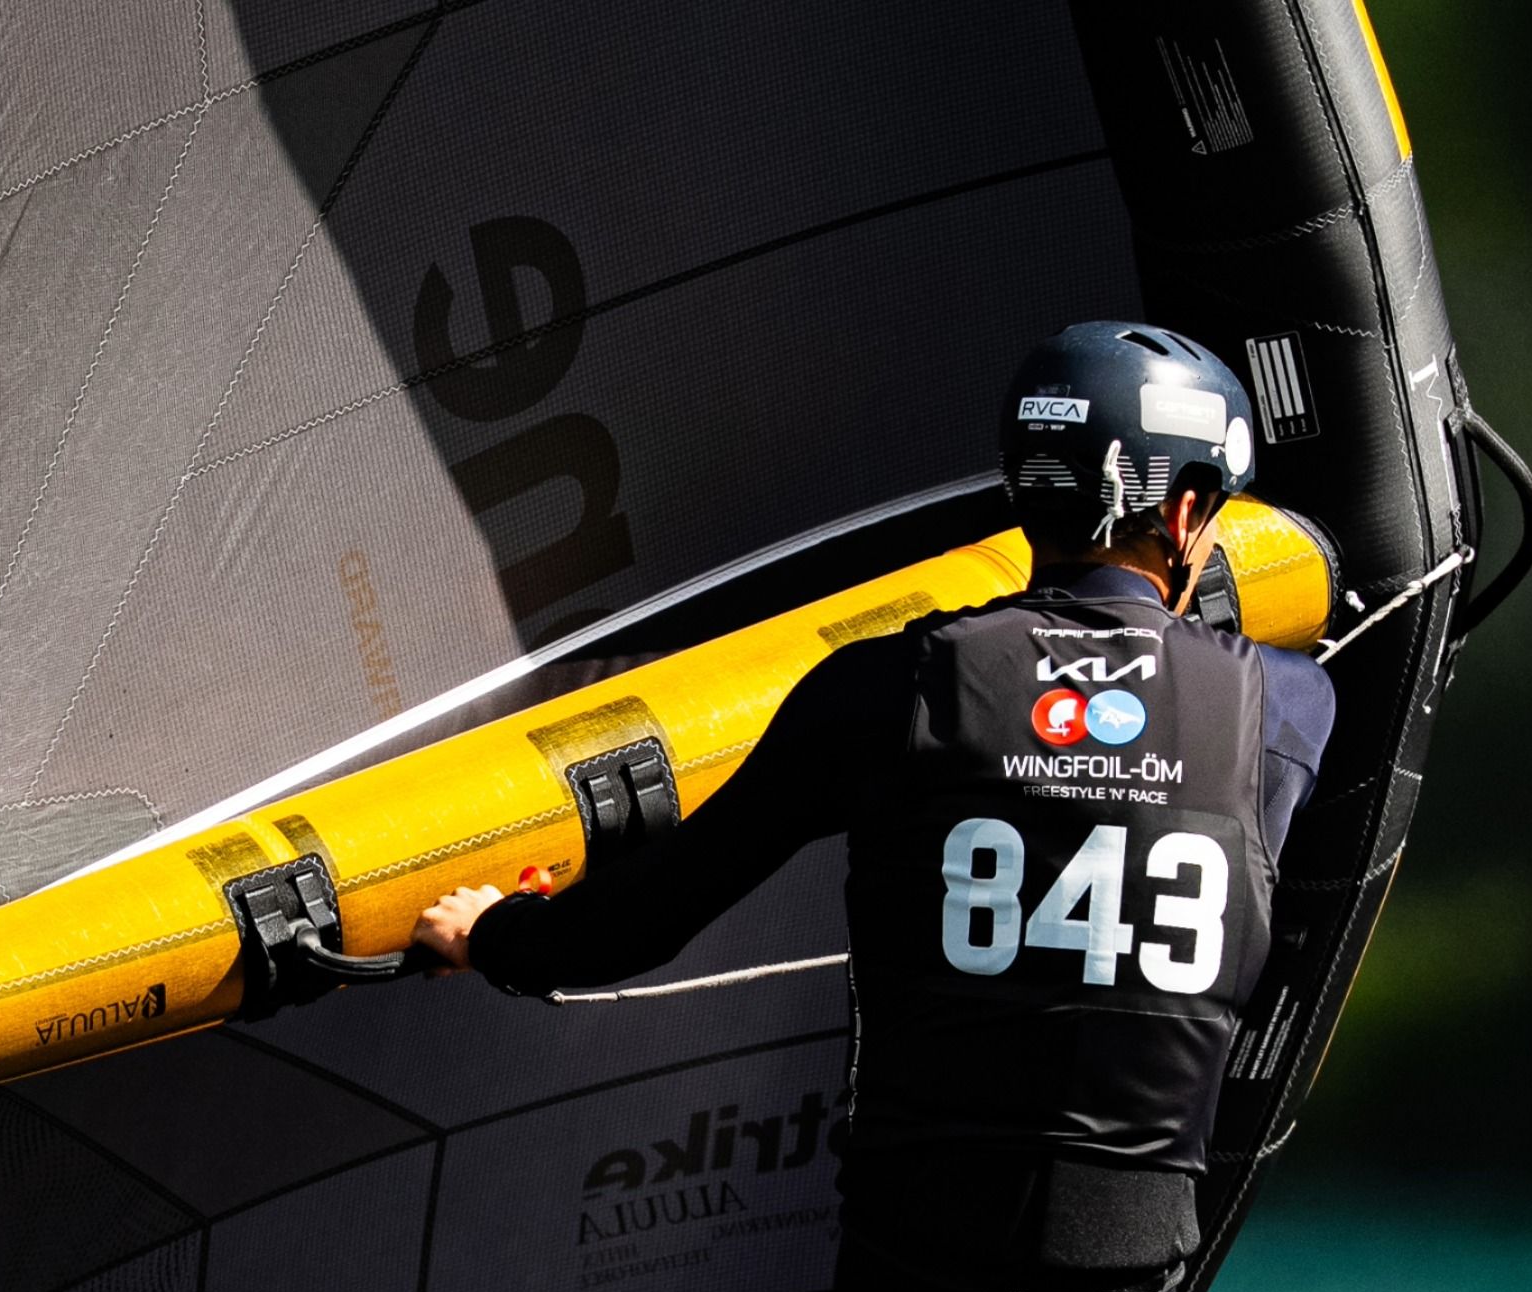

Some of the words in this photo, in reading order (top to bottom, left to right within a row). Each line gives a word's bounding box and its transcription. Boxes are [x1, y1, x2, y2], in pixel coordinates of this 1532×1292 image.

[1022, 401, 1081, 418] RVCA
[1032, 627, 1163, 644] MARINEPOOL
[1036, 655, 1156, 681] KIA
[1003, 753, 1183, 783] WINGFOIL-ÖM
[1024, 785, 1106, 799] FREESTYLE
[1129, 789, 1168, 804] RACE
[942, 817, 1230, 995] 843
